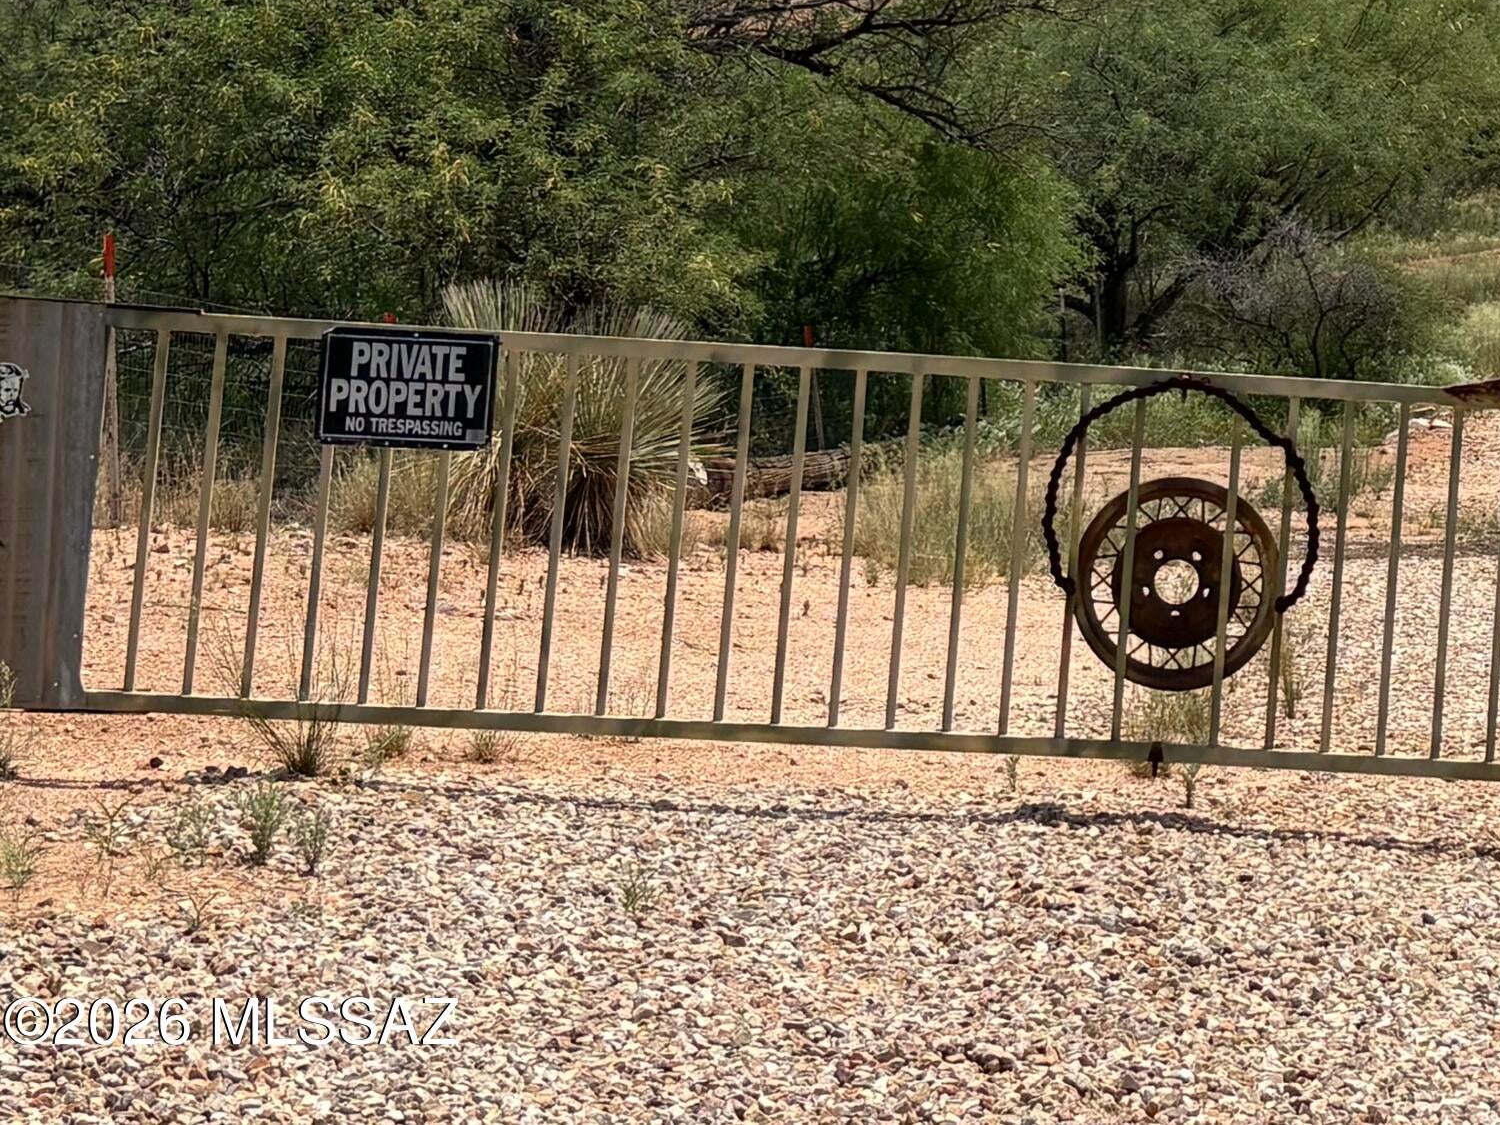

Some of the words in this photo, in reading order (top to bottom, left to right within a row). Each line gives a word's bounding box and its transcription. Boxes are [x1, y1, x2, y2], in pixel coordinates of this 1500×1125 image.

[350, 341, 467, 382] PRIVATE
[329, 378, 482, 419] PROPERTY
[345, 416, 365, 432] NO
[370, 417, 463, 436] TRESPASSING
